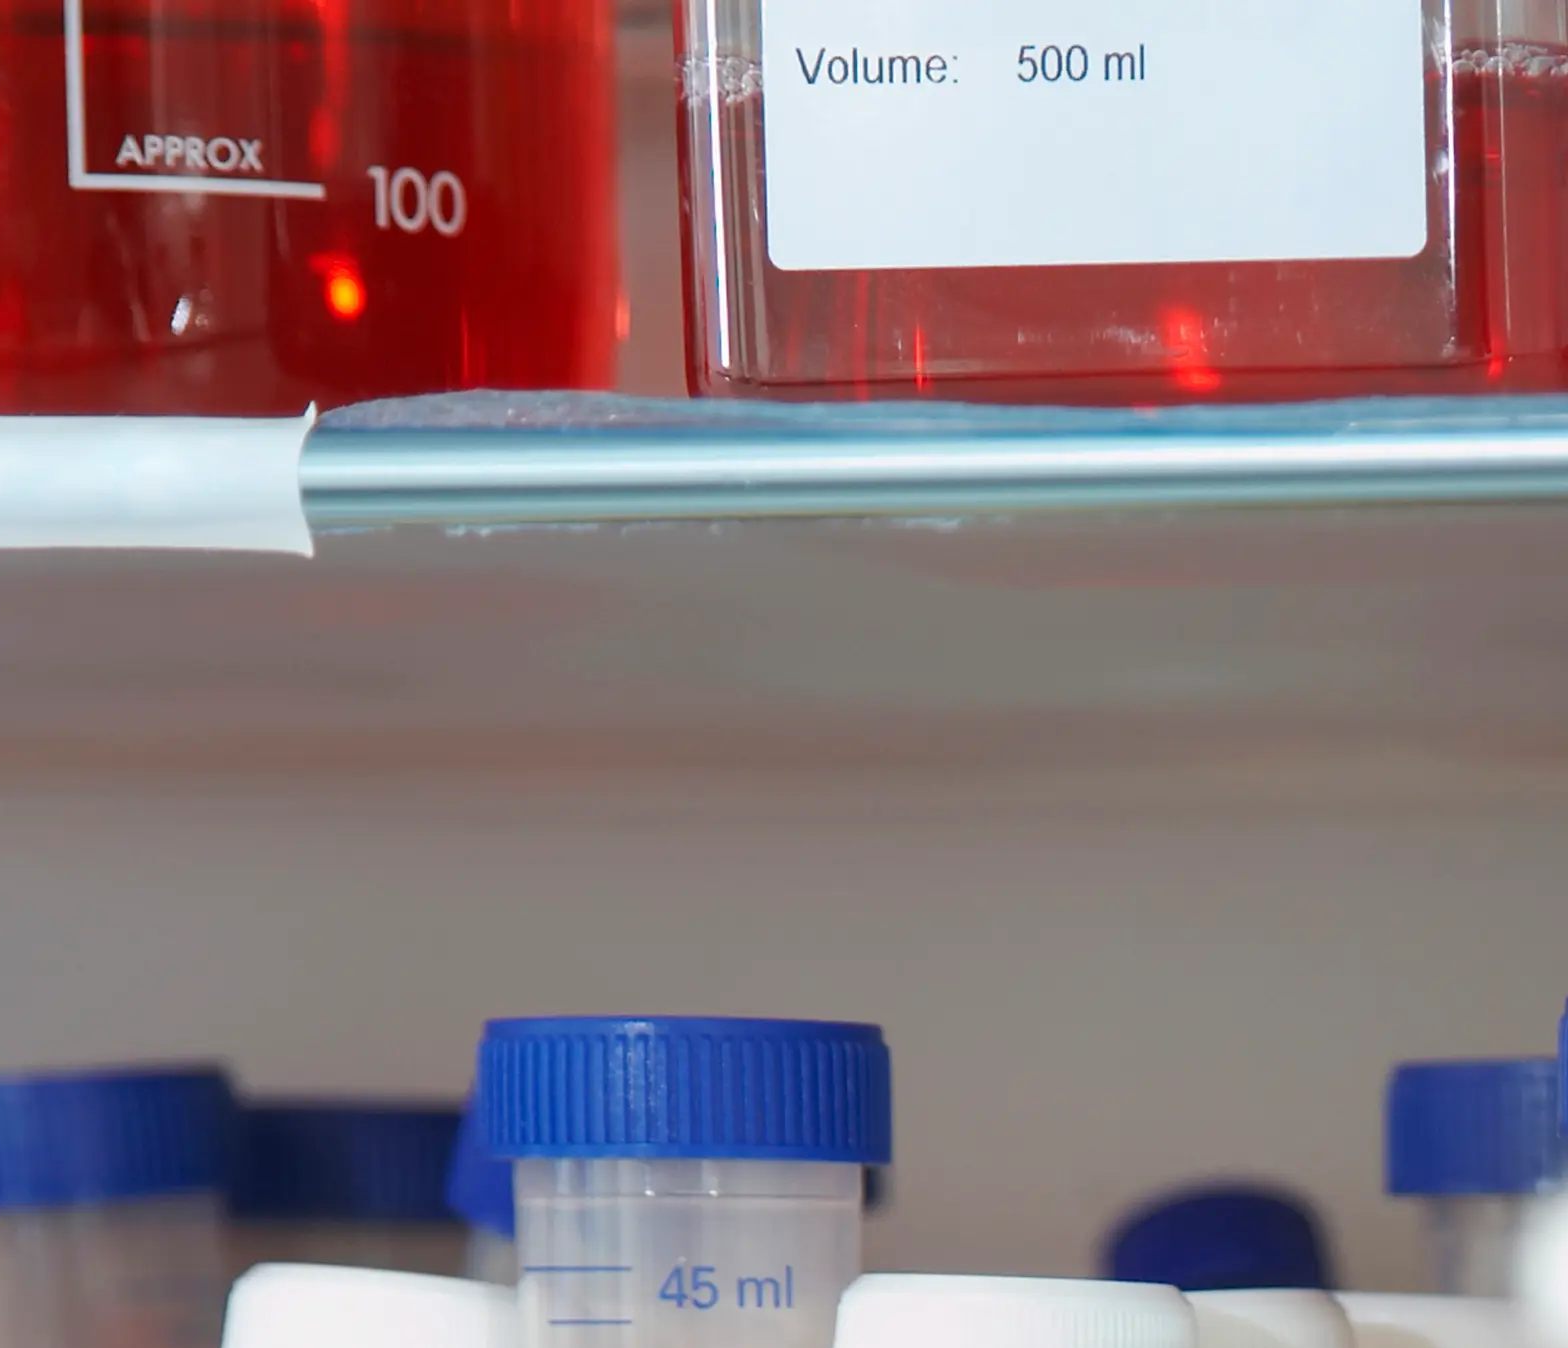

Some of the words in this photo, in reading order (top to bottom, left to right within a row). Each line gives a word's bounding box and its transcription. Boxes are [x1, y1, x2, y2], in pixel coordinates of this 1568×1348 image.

[795, 46, 960, 85] Volume:
[1017, 44, 1089, 82] 500
[1103, 43, 1146, 82] ml
[115, 133, 264, 173] APPROX
[367, 165, 467, 238] 100
[658, 1266, 719, 1310] 45
[736, 1264, 794, 1309] ml
